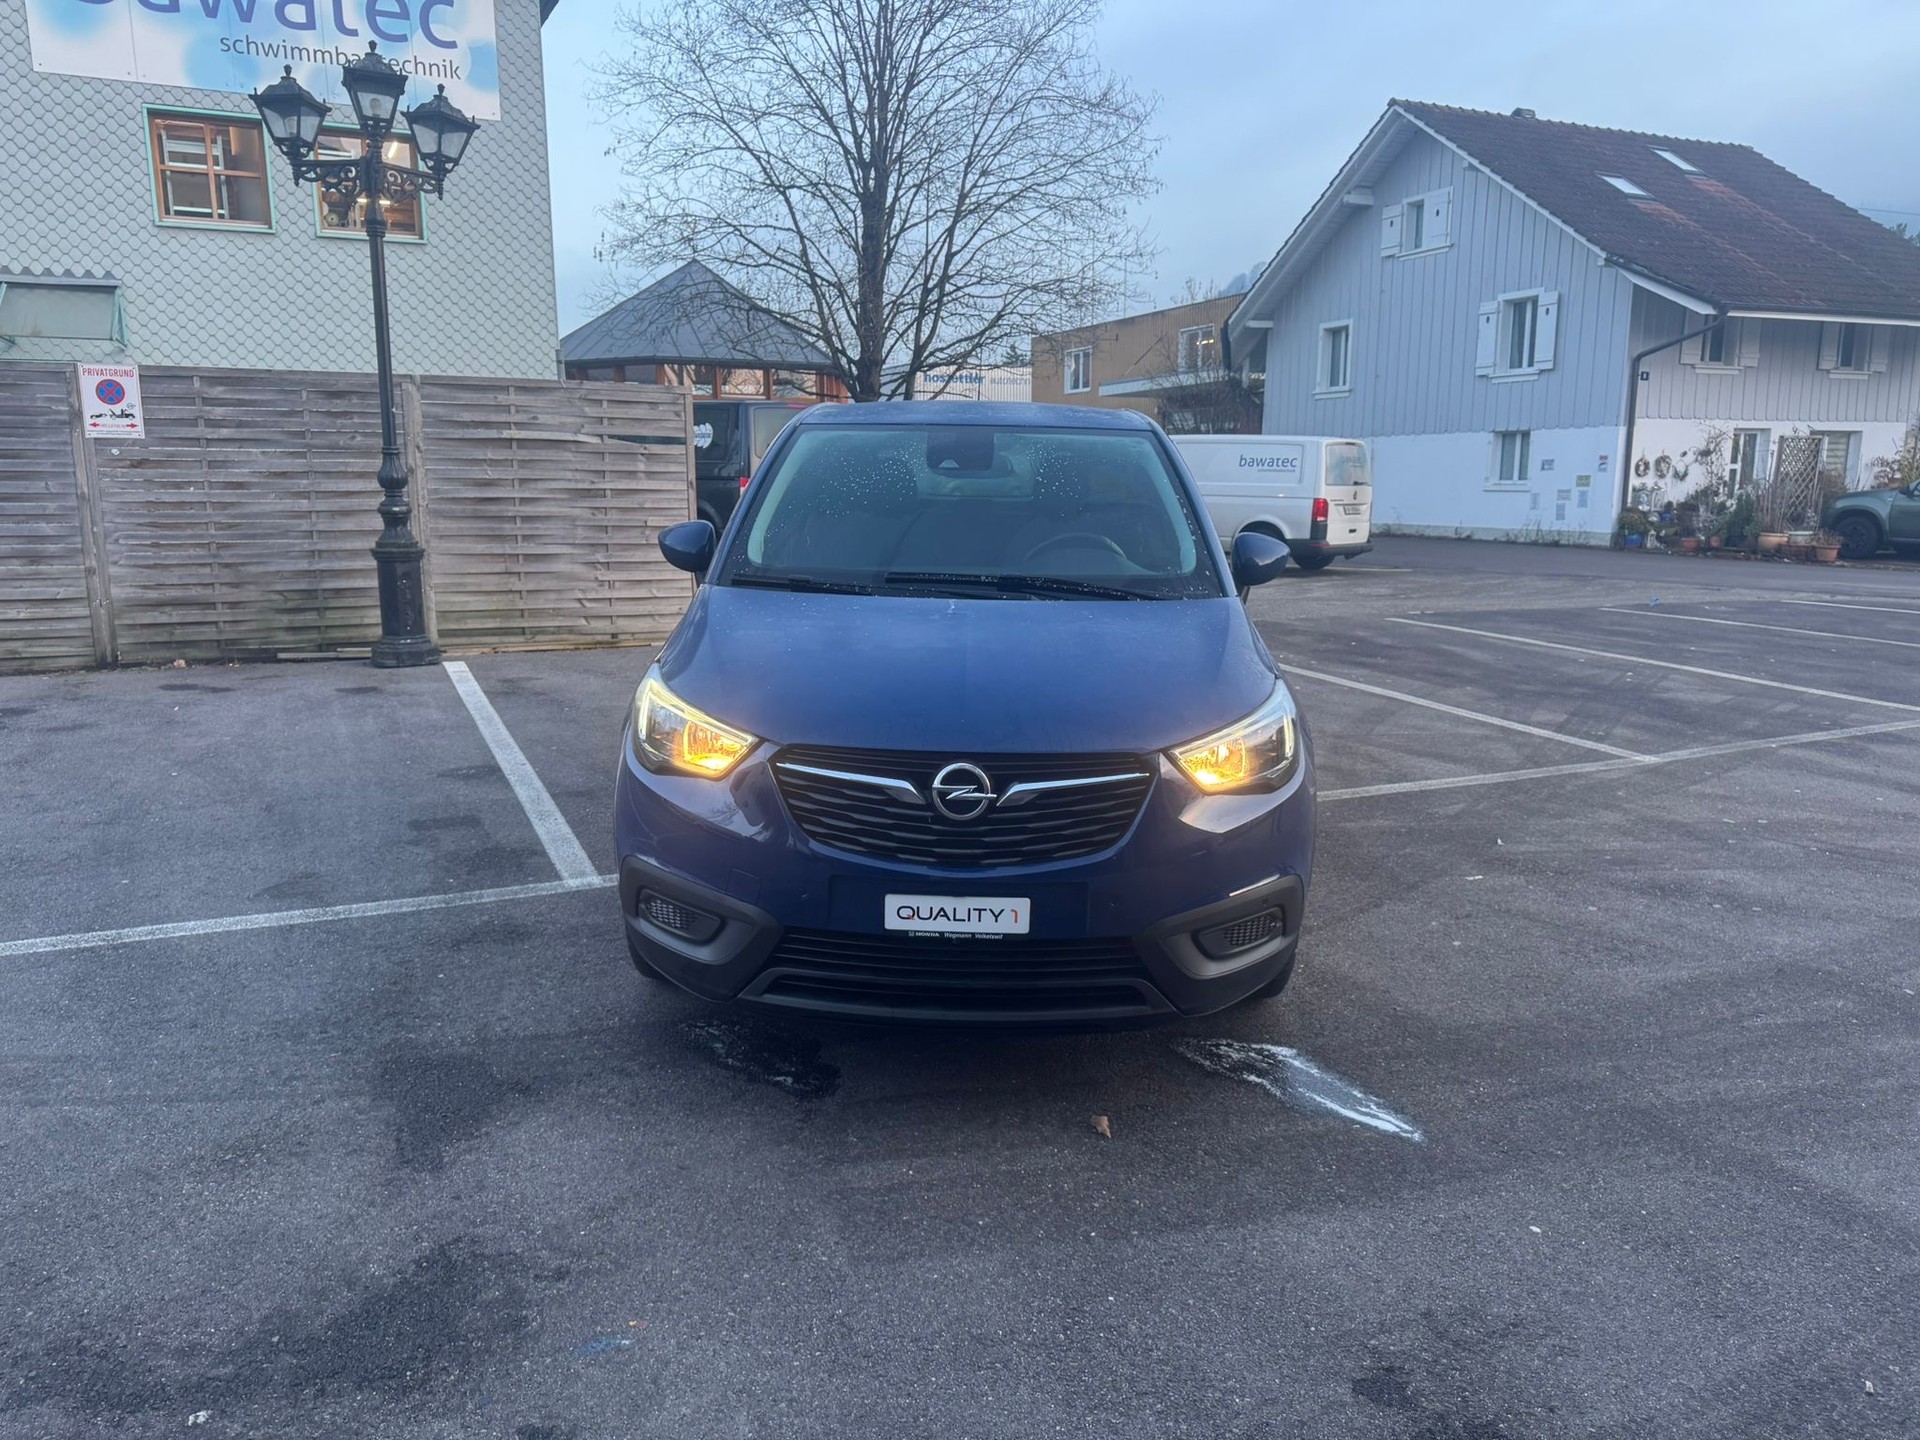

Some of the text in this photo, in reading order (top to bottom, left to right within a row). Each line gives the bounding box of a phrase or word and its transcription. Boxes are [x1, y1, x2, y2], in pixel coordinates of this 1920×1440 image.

[82, 367, 135, 378] PRIVATGRUND
[1239, 454, 1298, 468] bawatec
[896, 905, 1019, 924] QUALITY 1
